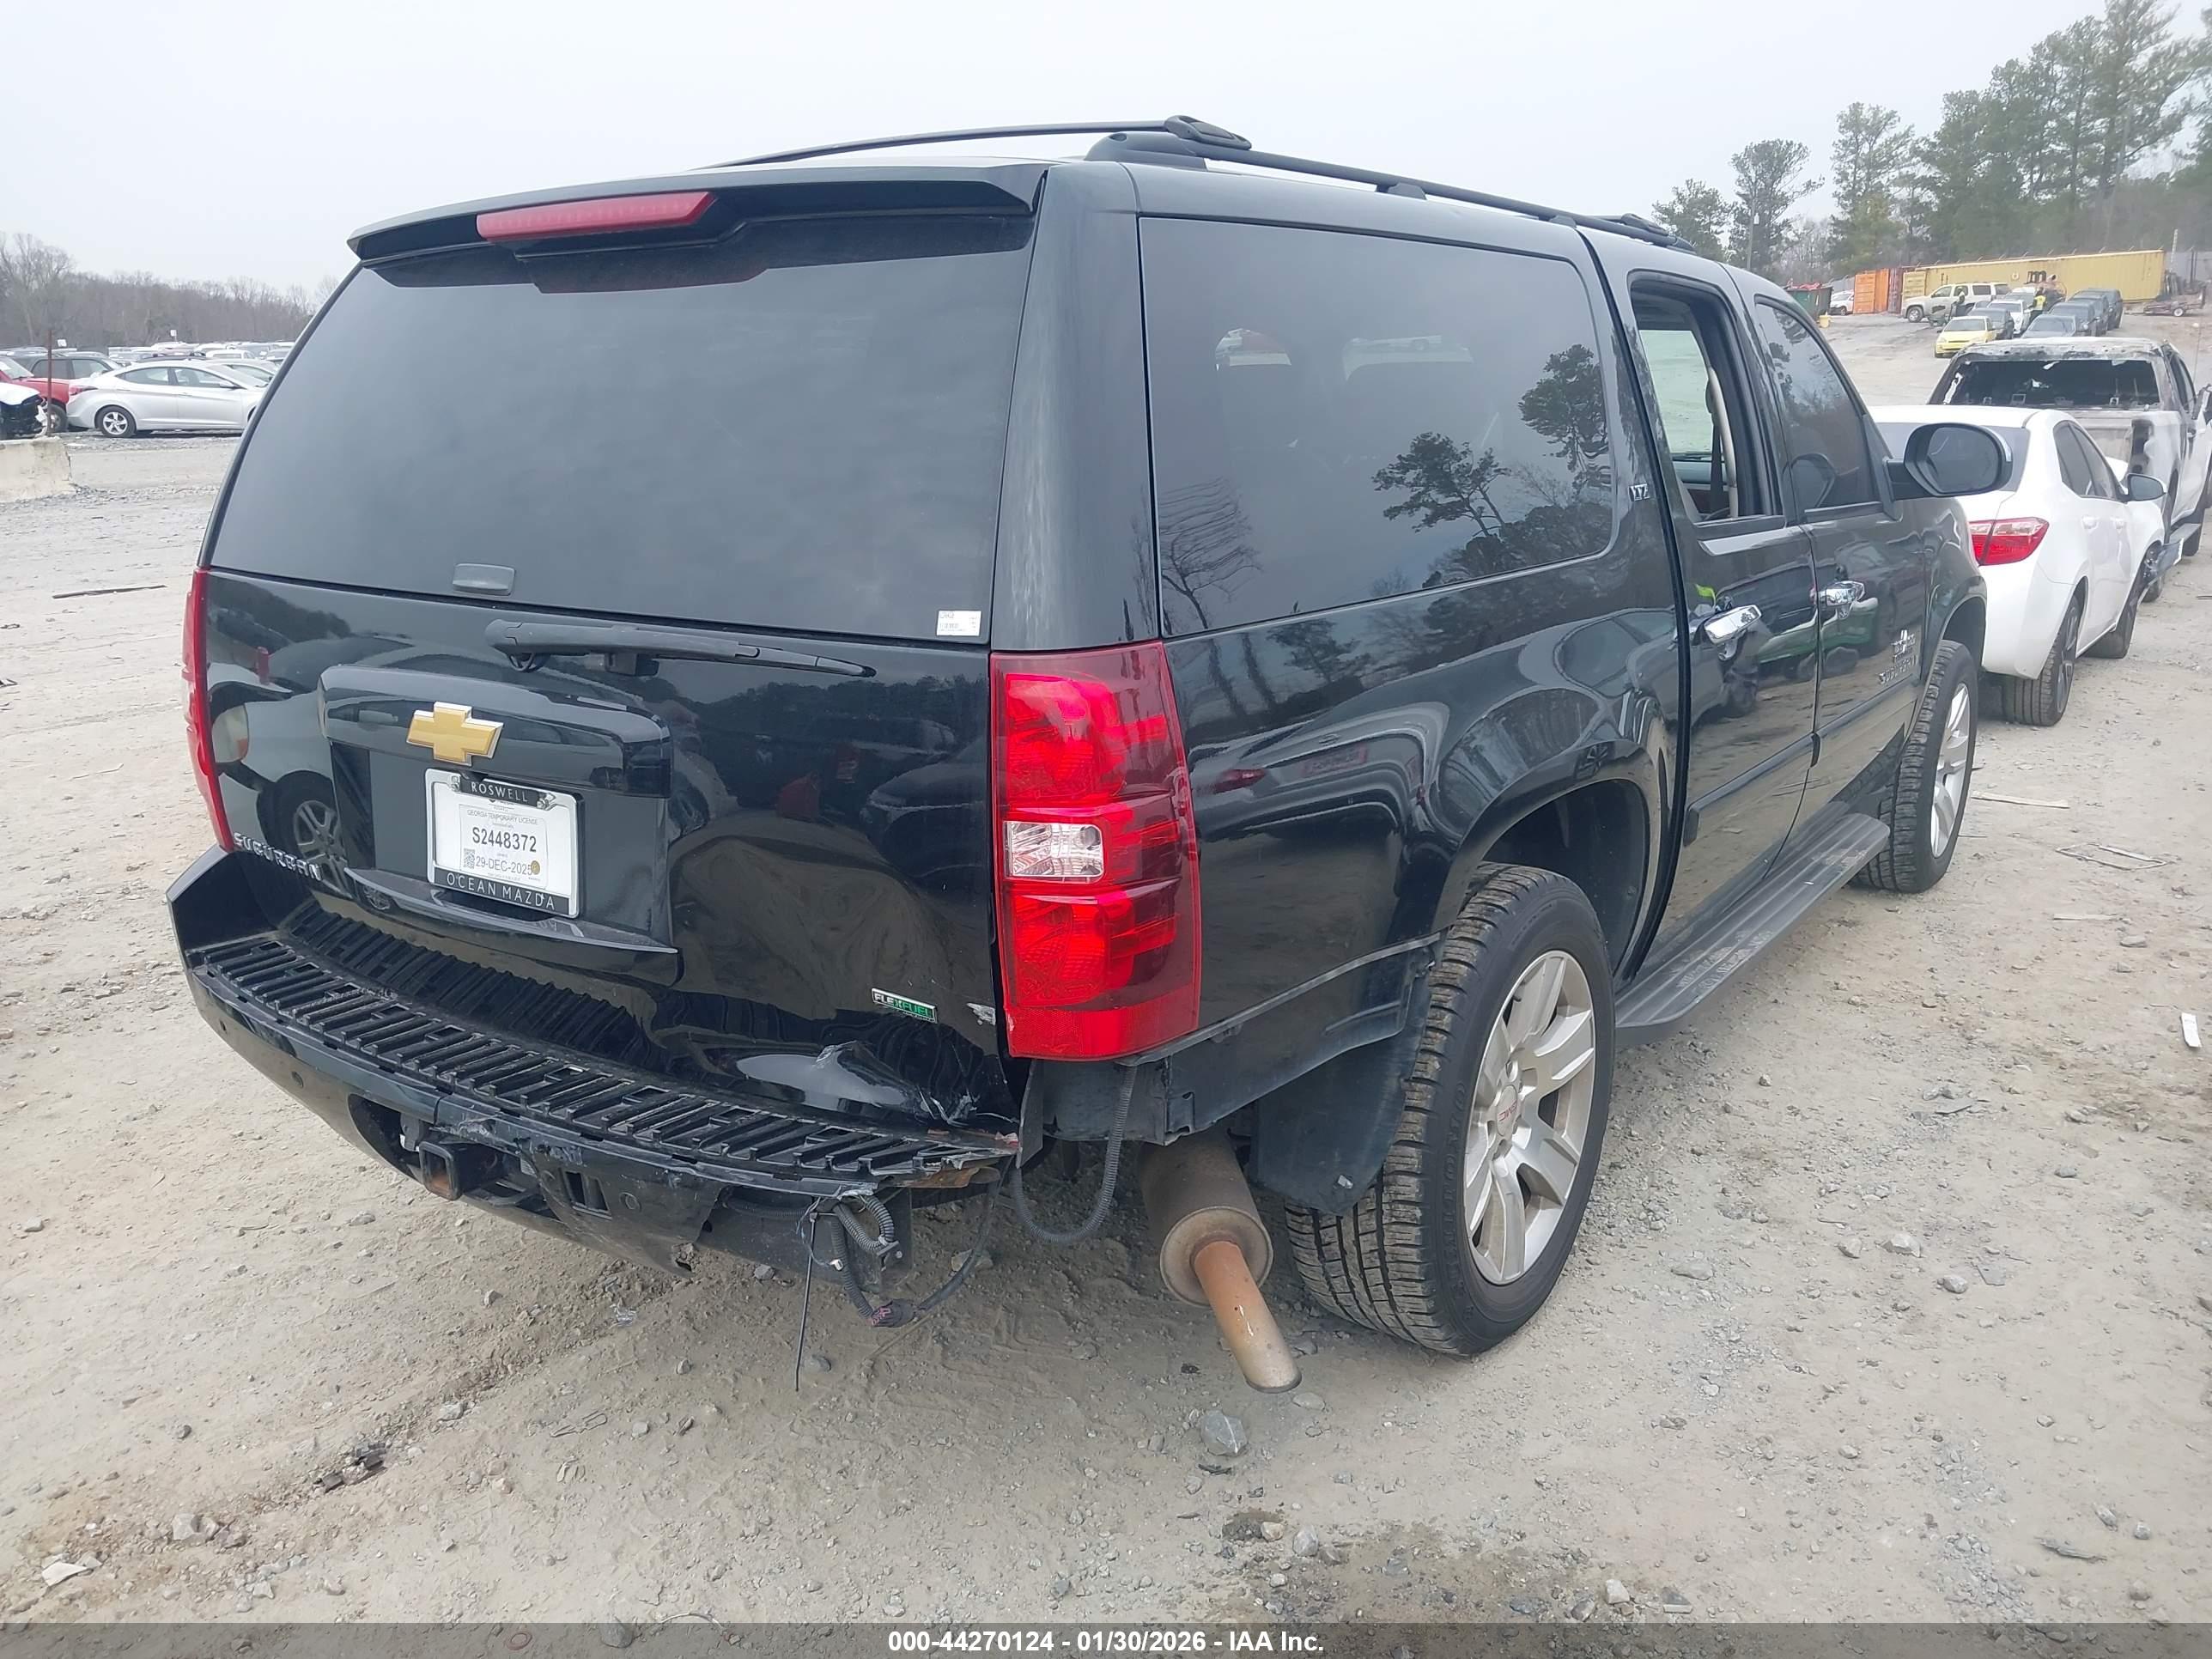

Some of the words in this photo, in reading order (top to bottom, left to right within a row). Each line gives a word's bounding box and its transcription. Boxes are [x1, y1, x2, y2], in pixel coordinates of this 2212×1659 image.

[1628, 483, 1650, 501] LTZ
[471, 781, 528, 802] ROSWELL
[466, 809, 487, 817] GEORGIA
[488, 812, 518, 823] TEMPORARY
[471, 826, 537, 853] S2448372
[476, 855, 532, 876] 29-DEC-2025
[447, 872, 495, 896] OCEAN
[502, 886, 555, 910] MAZDA
